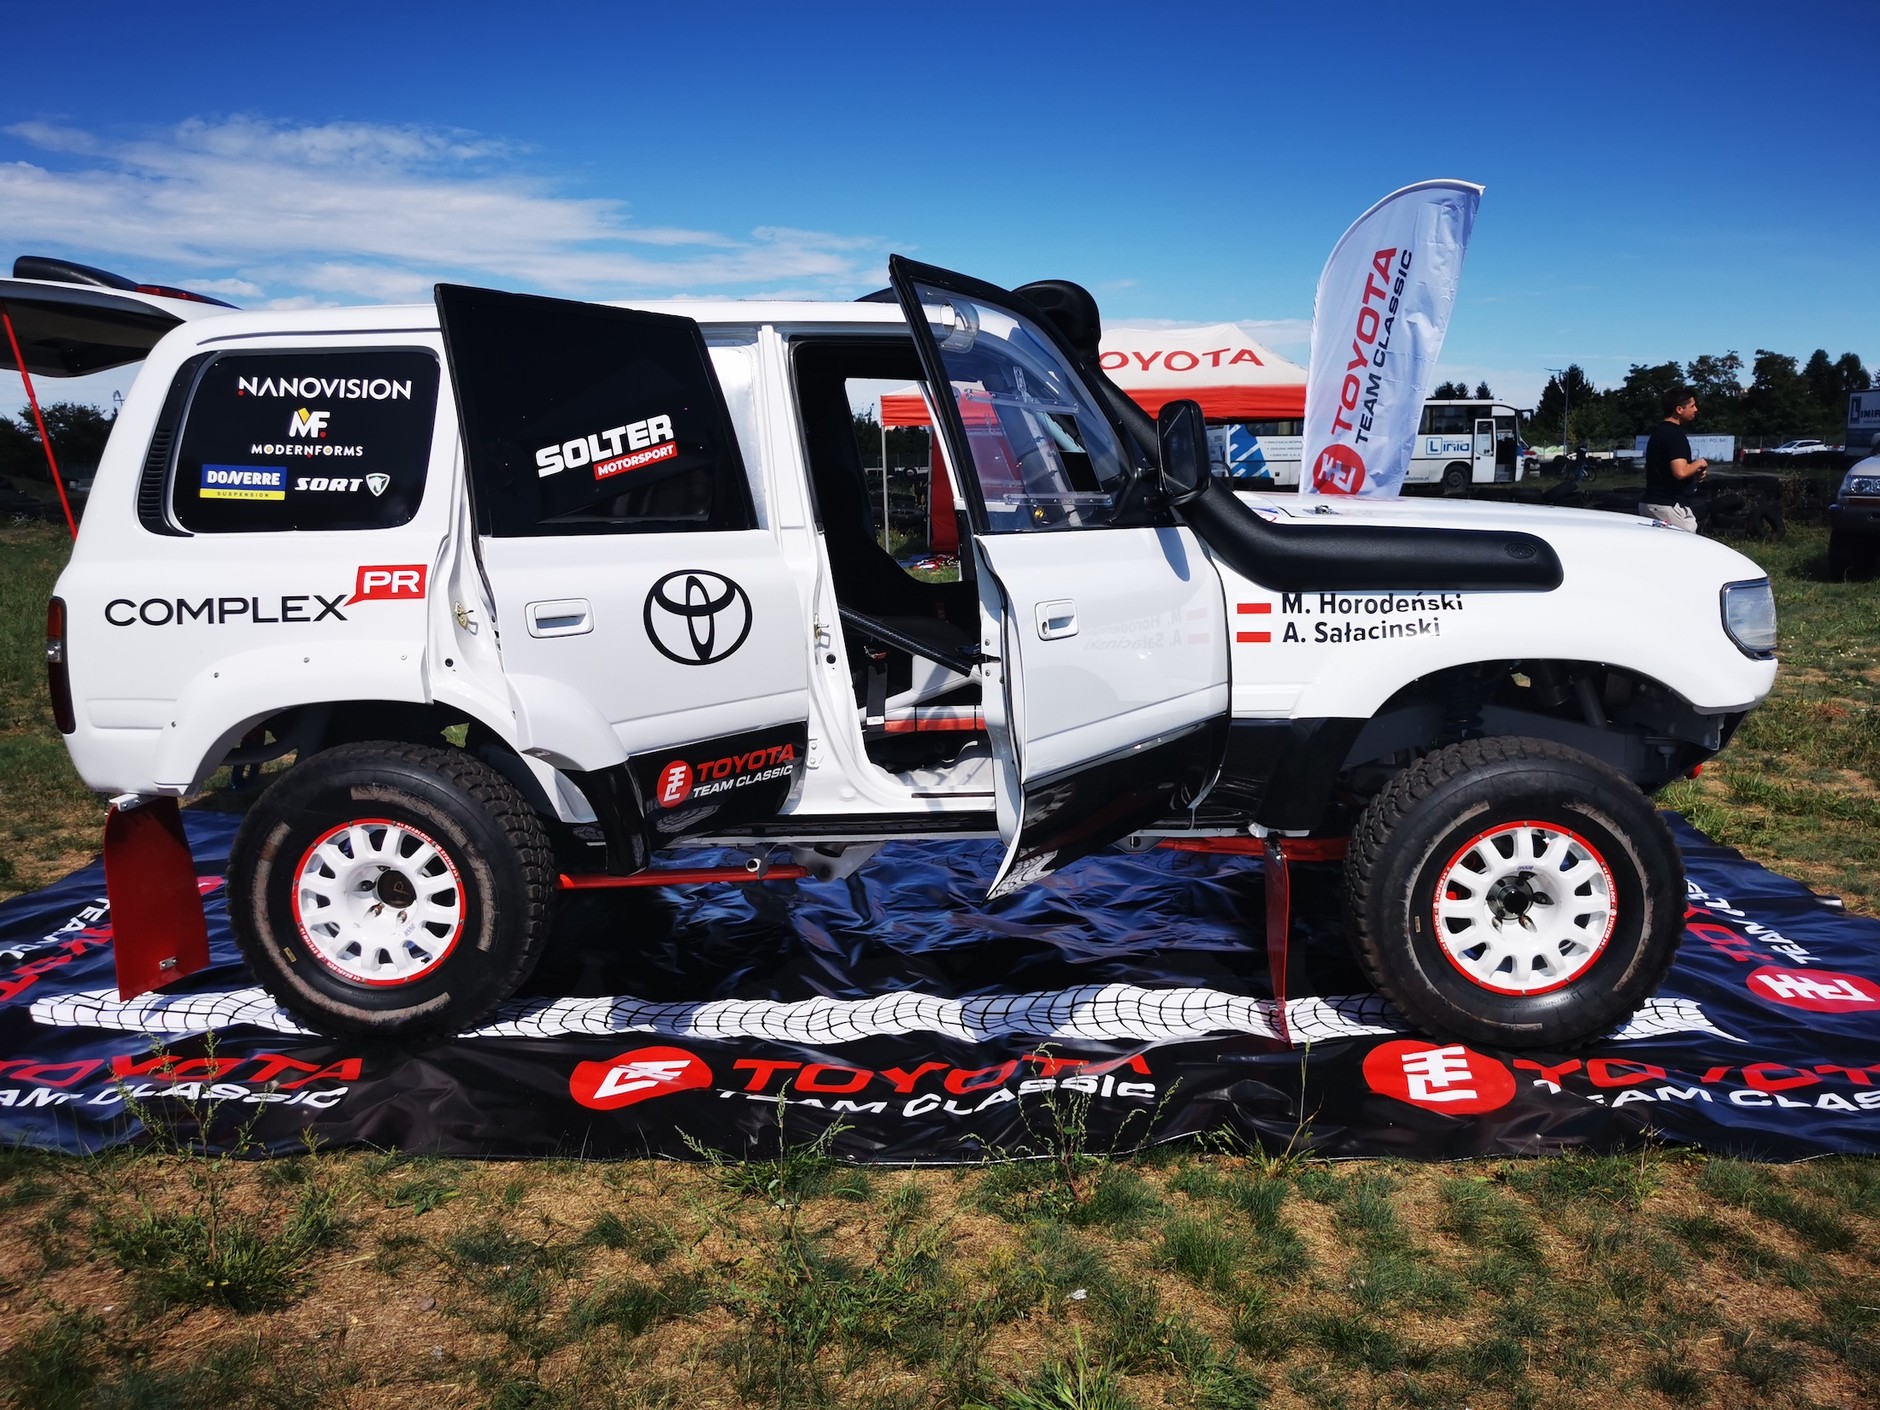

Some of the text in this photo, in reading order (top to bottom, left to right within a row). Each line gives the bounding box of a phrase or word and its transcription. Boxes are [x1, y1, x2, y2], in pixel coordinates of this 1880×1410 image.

[1331, 247, 1397, 435] TOYOTA
[1355, 249, 1412, 444] TEAM CLASSIC
[1098, 348, 1264, 372] OYOTA
[238, 376, 412, 400] NANOVISION
[251, 444, 364, 458] MODERNFORMS
[536, 414, 675, 478] SOLTER
[597, 443, 675, 477] MOTORSPORT
[294, 477, 363, 492] SORT
[363, 569, 420, 594] PR
[105, 594, 349, 626] COMPLEX
[1282, 592, 1463, 614] M. Horodeński
[1282, 617, 1441, 643] A. Sałacinski
[697, 743, 795, 782] TOYOTA
[693, 765, 793, 798] TEAM CLASSIC
